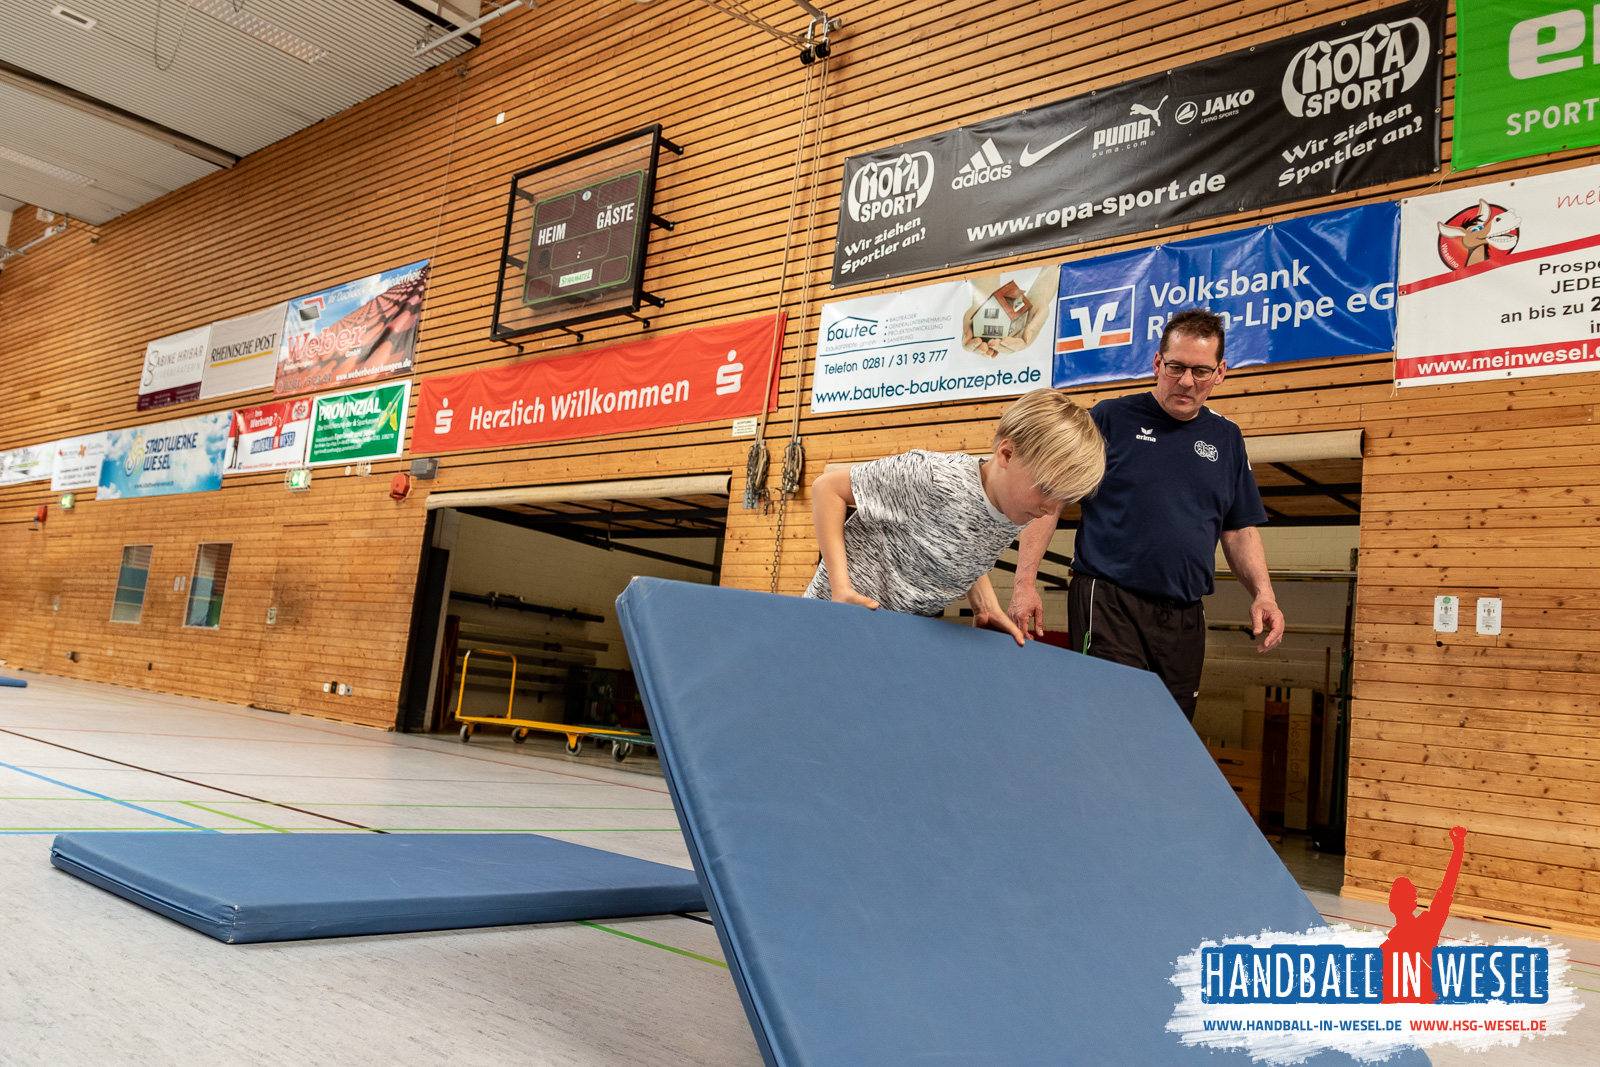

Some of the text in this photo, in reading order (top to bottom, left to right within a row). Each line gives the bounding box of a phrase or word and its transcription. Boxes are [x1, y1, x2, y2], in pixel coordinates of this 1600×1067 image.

[1509, 8, 1600, 80] e
[1302, 23, 1405, 94] ROPA
[1201, 89, 1255, 117] JAKO
[1305, 72, 1400, 118] SPORT
[1200, 109, 1240, 124] LIVING SPORTS
[1093, 118, 1151, 150] PUMA
[1281, 103, 1412, 164] Wir ziehen
[1091, 140, 1147, 158] puma.com
[1278, 138, 1377, 187] Sportler
[859, 154, 920, 202] ROPA
[951, 163, 1013, 191] adidas
[596, 202, 635, 230] GÄSTE
[860, 191, 917, 223] SPORT
[966, 172, 1227, 242] www.ropa-sport.de
[538, 222, 567, 246] HEIM
[844, 215, 922, 257] Wir ziehen
[841, 240, 901, 275] Sportler
[1441, 242, 1459, 269] Weselino
[1150, 259, 1310, 308] Volksbank
[1346, 282, 1395, 313] eG
[889, 312, 918, 323] BAUTRÄGER
[1501, 311, 1522, 324] an
[1529, 304, 1556, 320] bis
[1562, 303, 1584, 316] zu
[286, 324, 368, 363] Weber
[827, 323, 878, 342] bautec
[886, 334, 914, 344] SANIERUNG
[888, 324, 944, 336] PROJEKTENTWICKLUNG
[211, 333, 277, 362] RHEINISCHE POST
[824, 361, 858, 375] Telefon
[862, 356, 886, 370] 0281
[896, 353, 908, 366] 31
[912, 351, 926, 365] 93
[928, 349, 949, 363] 777
[815, 366, 1042, 404] www.bautec-baukonzepte.de
[319, 397, 381, 421] PROVINZIAL
[469, 379, 690, 431] Herzlich Willkommen
[144, 432, 198, 454] STADTWERKE
[1136, 434, 1156, 442] erima
[144, 454, 170, 472] WESEL
